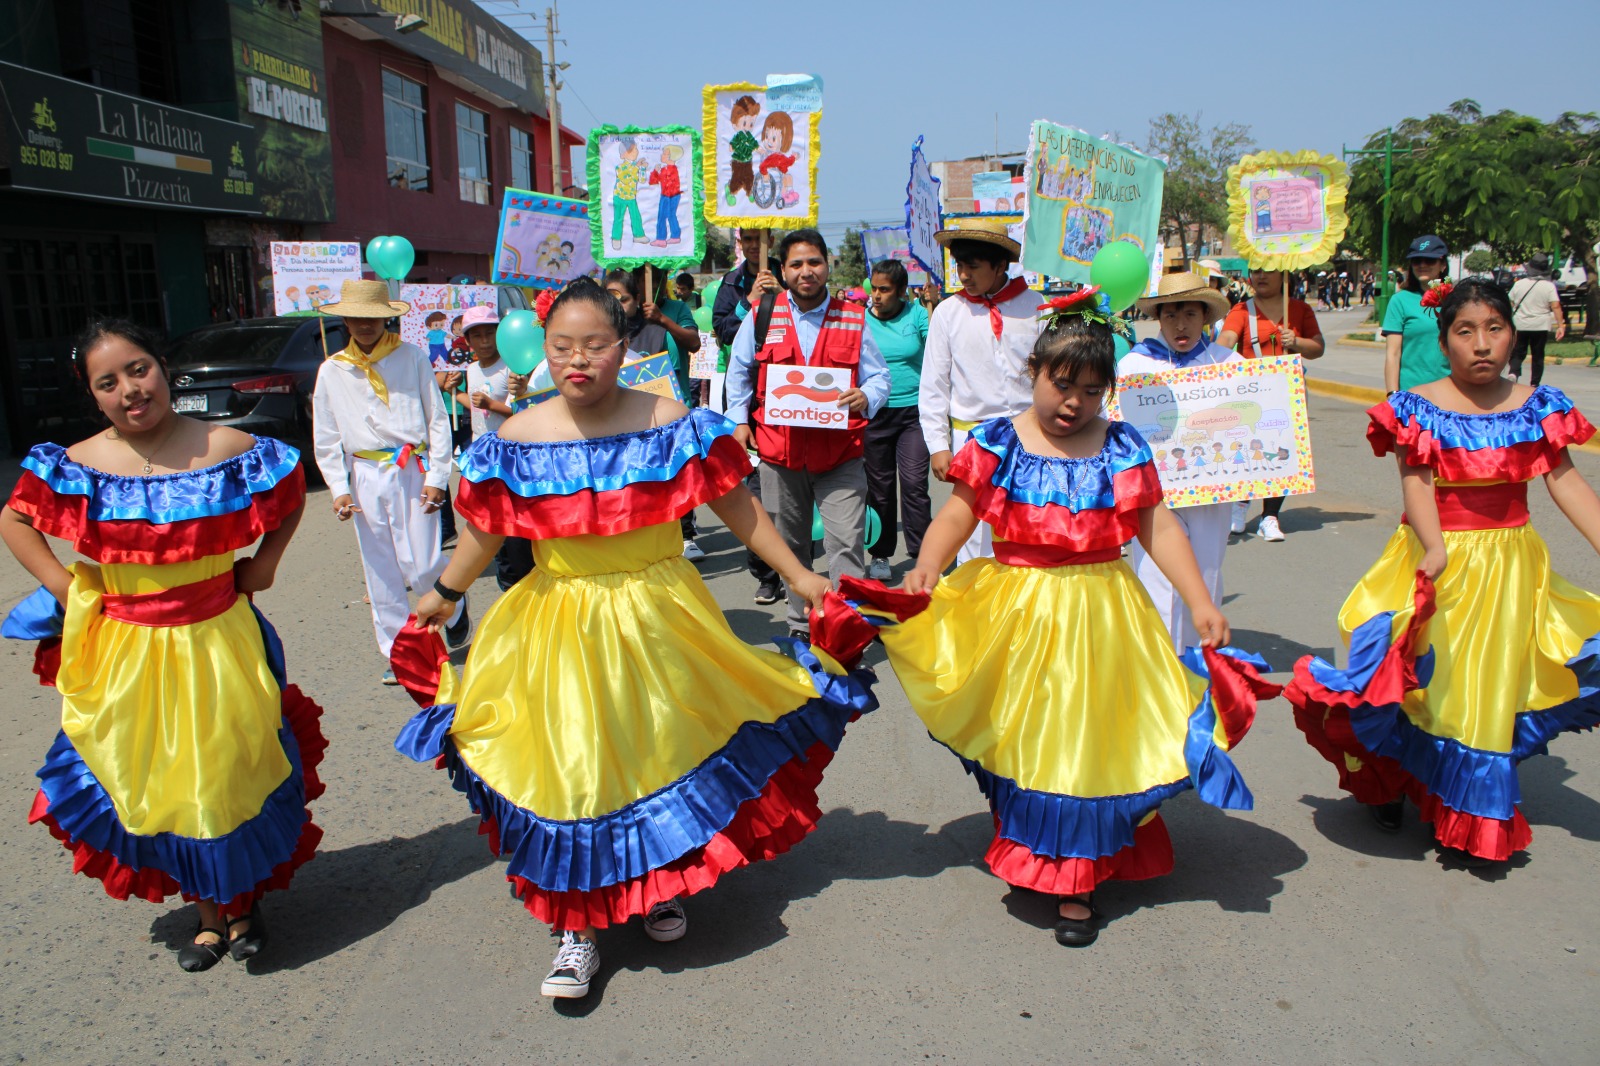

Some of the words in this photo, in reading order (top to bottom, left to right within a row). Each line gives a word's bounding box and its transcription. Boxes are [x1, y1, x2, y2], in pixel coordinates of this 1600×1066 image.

[252, 48, 312, 90] PARRILLADAS
[475, 24, 492, 72] EL
[488, 33, 527, 90] PORTAL
[95, 93, 128, 138] La
[132, 103, 205, 154] Italiana
[246, 76, 273, 118] EL
[269, 84, 327, 132] PORTAL
[20, 145, 39, 166] 955
[40, 148, 57, 169] 028
[58, 152, 74, 171] 997
[1038, 125, 1058, 149] LAS
[1119, 155, 1136, 176] NOS
[122, 165, 193, 204] Pizzería
[1136, 385, 1230, 407] Inclusión
[1236, 382, 1272, 396] es...
[768, 407, 845, 425] contigo
[1191, 415, 1239, 427] Aceptación
[1257, 419, 1288, 428] Cuidar
